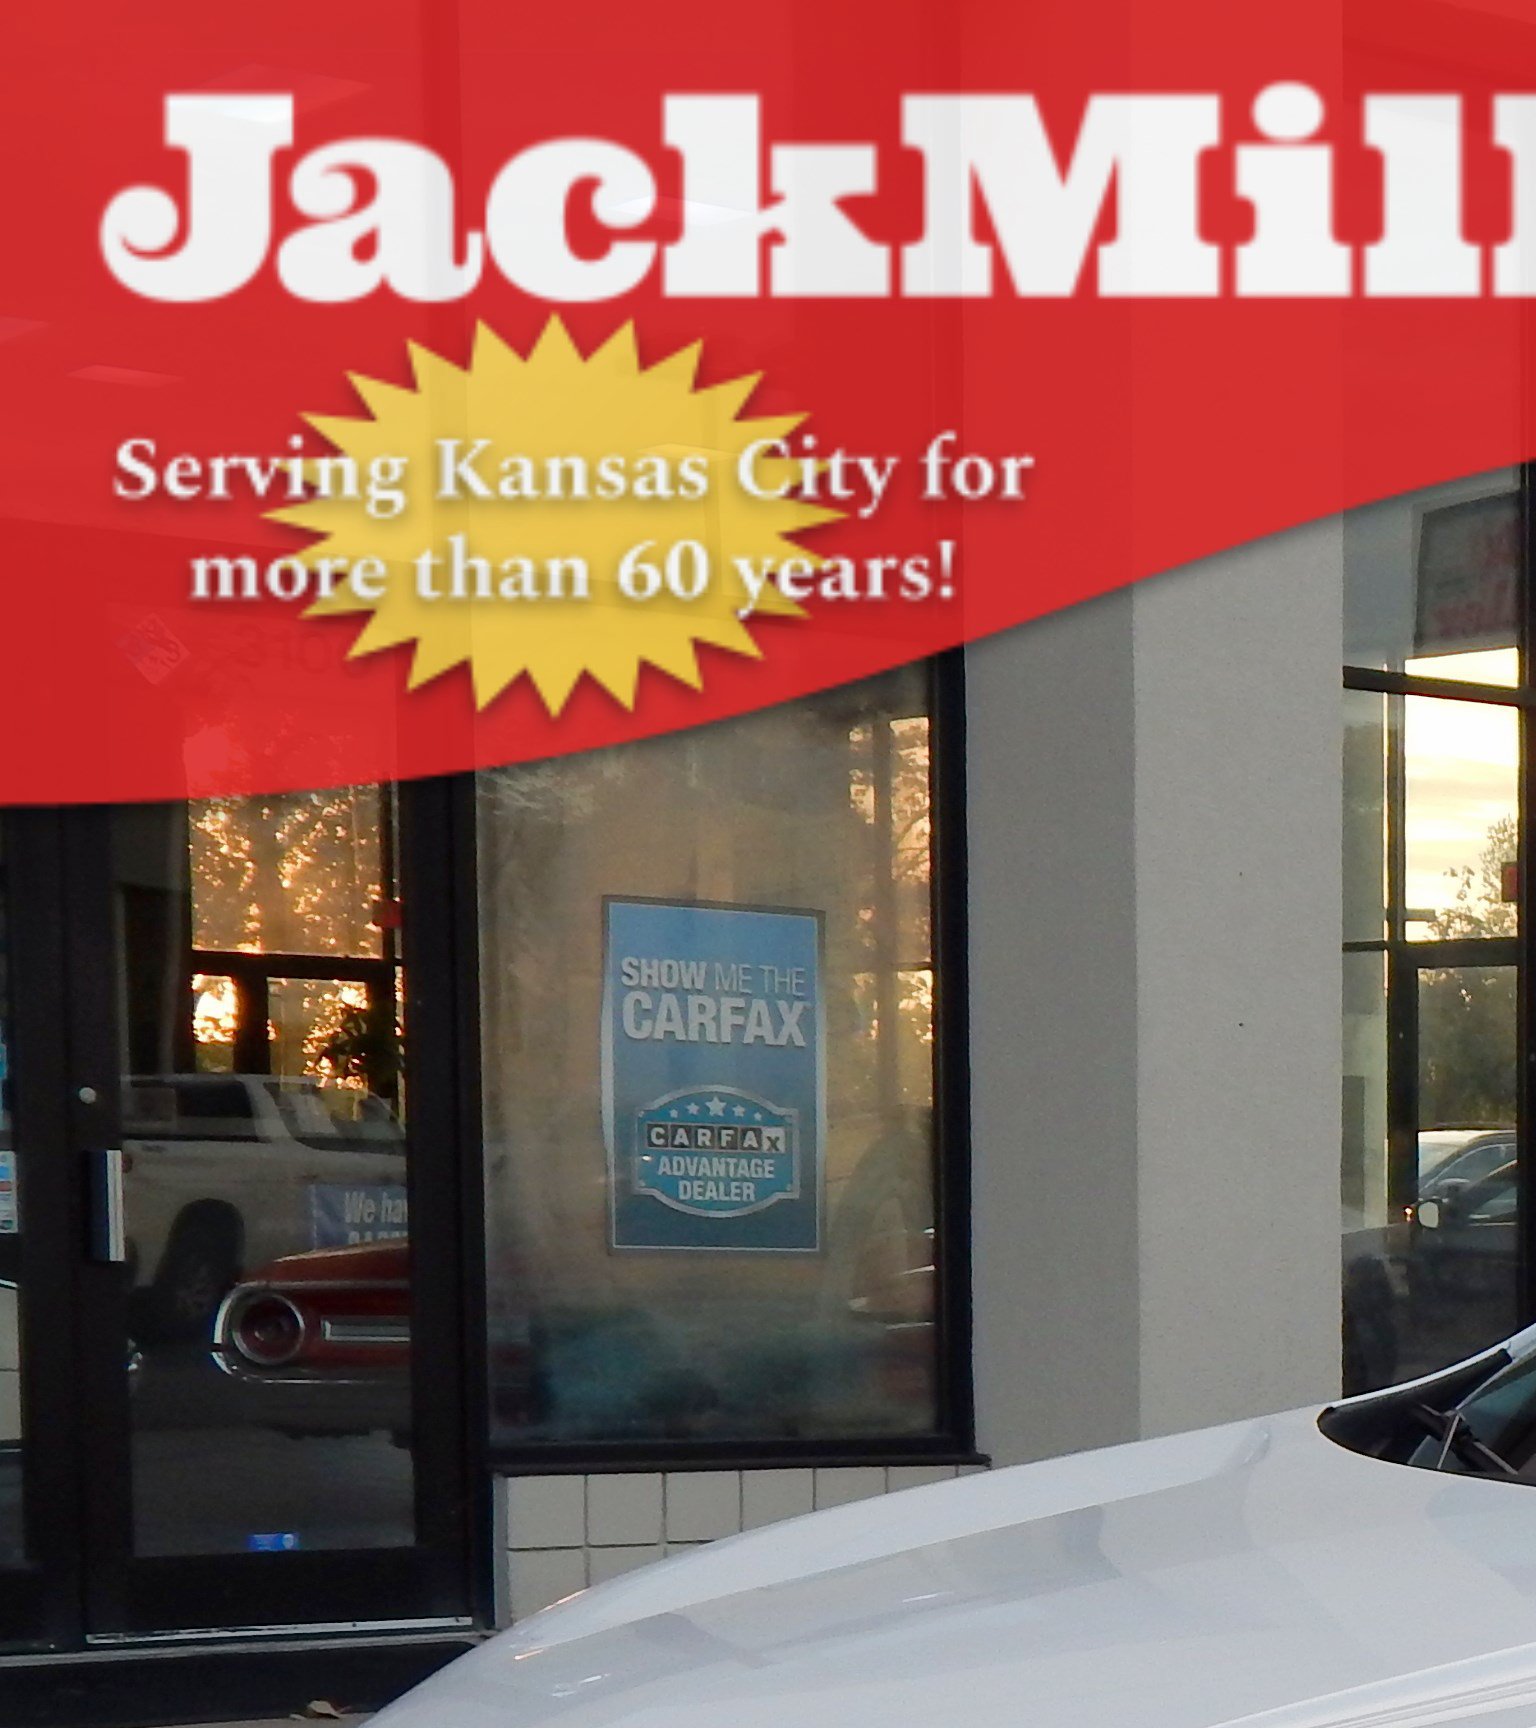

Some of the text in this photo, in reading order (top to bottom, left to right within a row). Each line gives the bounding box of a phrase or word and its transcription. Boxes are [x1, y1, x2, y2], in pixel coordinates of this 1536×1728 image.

[621, 956, 806, 997] SHOW ME THE
[622, 990, 808, 1048] CARFAX
[649, 1125, 781, 1152] CARFAX
[658, 1155, 776, 1179] ADVANTAGE
[677, 1180, 756, 1202] DEALER
